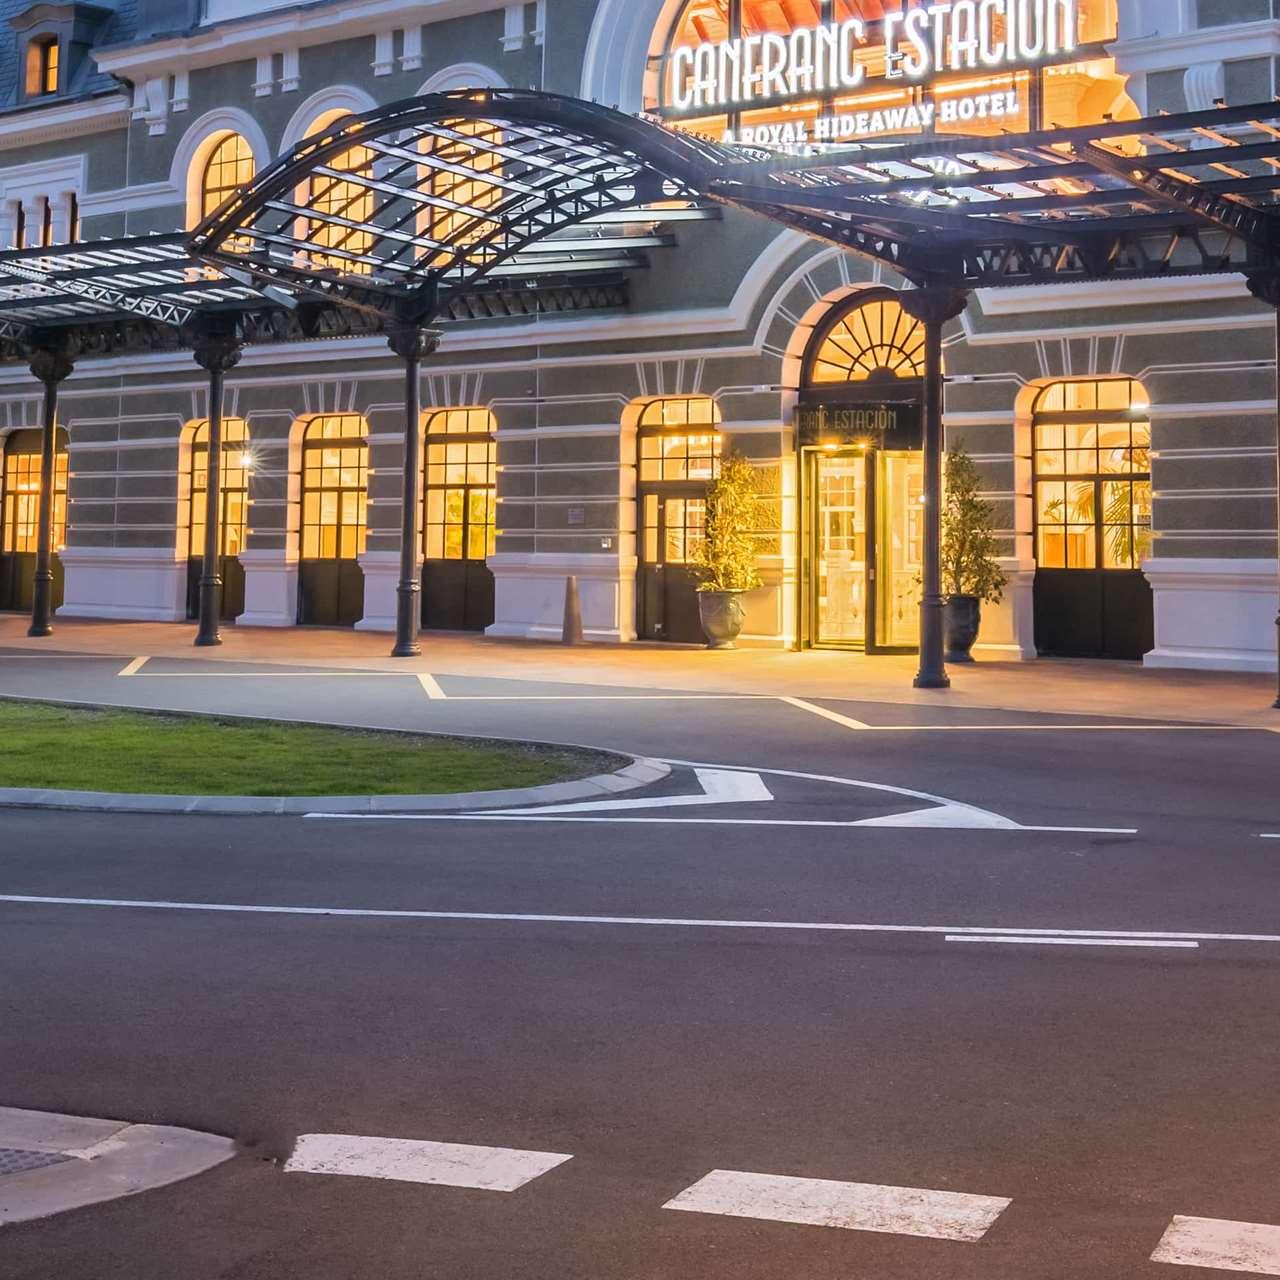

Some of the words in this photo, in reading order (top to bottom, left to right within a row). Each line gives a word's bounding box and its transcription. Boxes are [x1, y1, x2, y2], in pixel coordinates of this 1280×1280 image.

[672, 18, 864, 109] CANFRANC
[721, 129, 739, 143] A
[742, 121, 807, 144] ROYAL
[814, 104, 933, 139] HIDEAWAY
[940, 91, 1019, 122] HOTEL
[834, 406, 897, 430] ESTACIÓN
